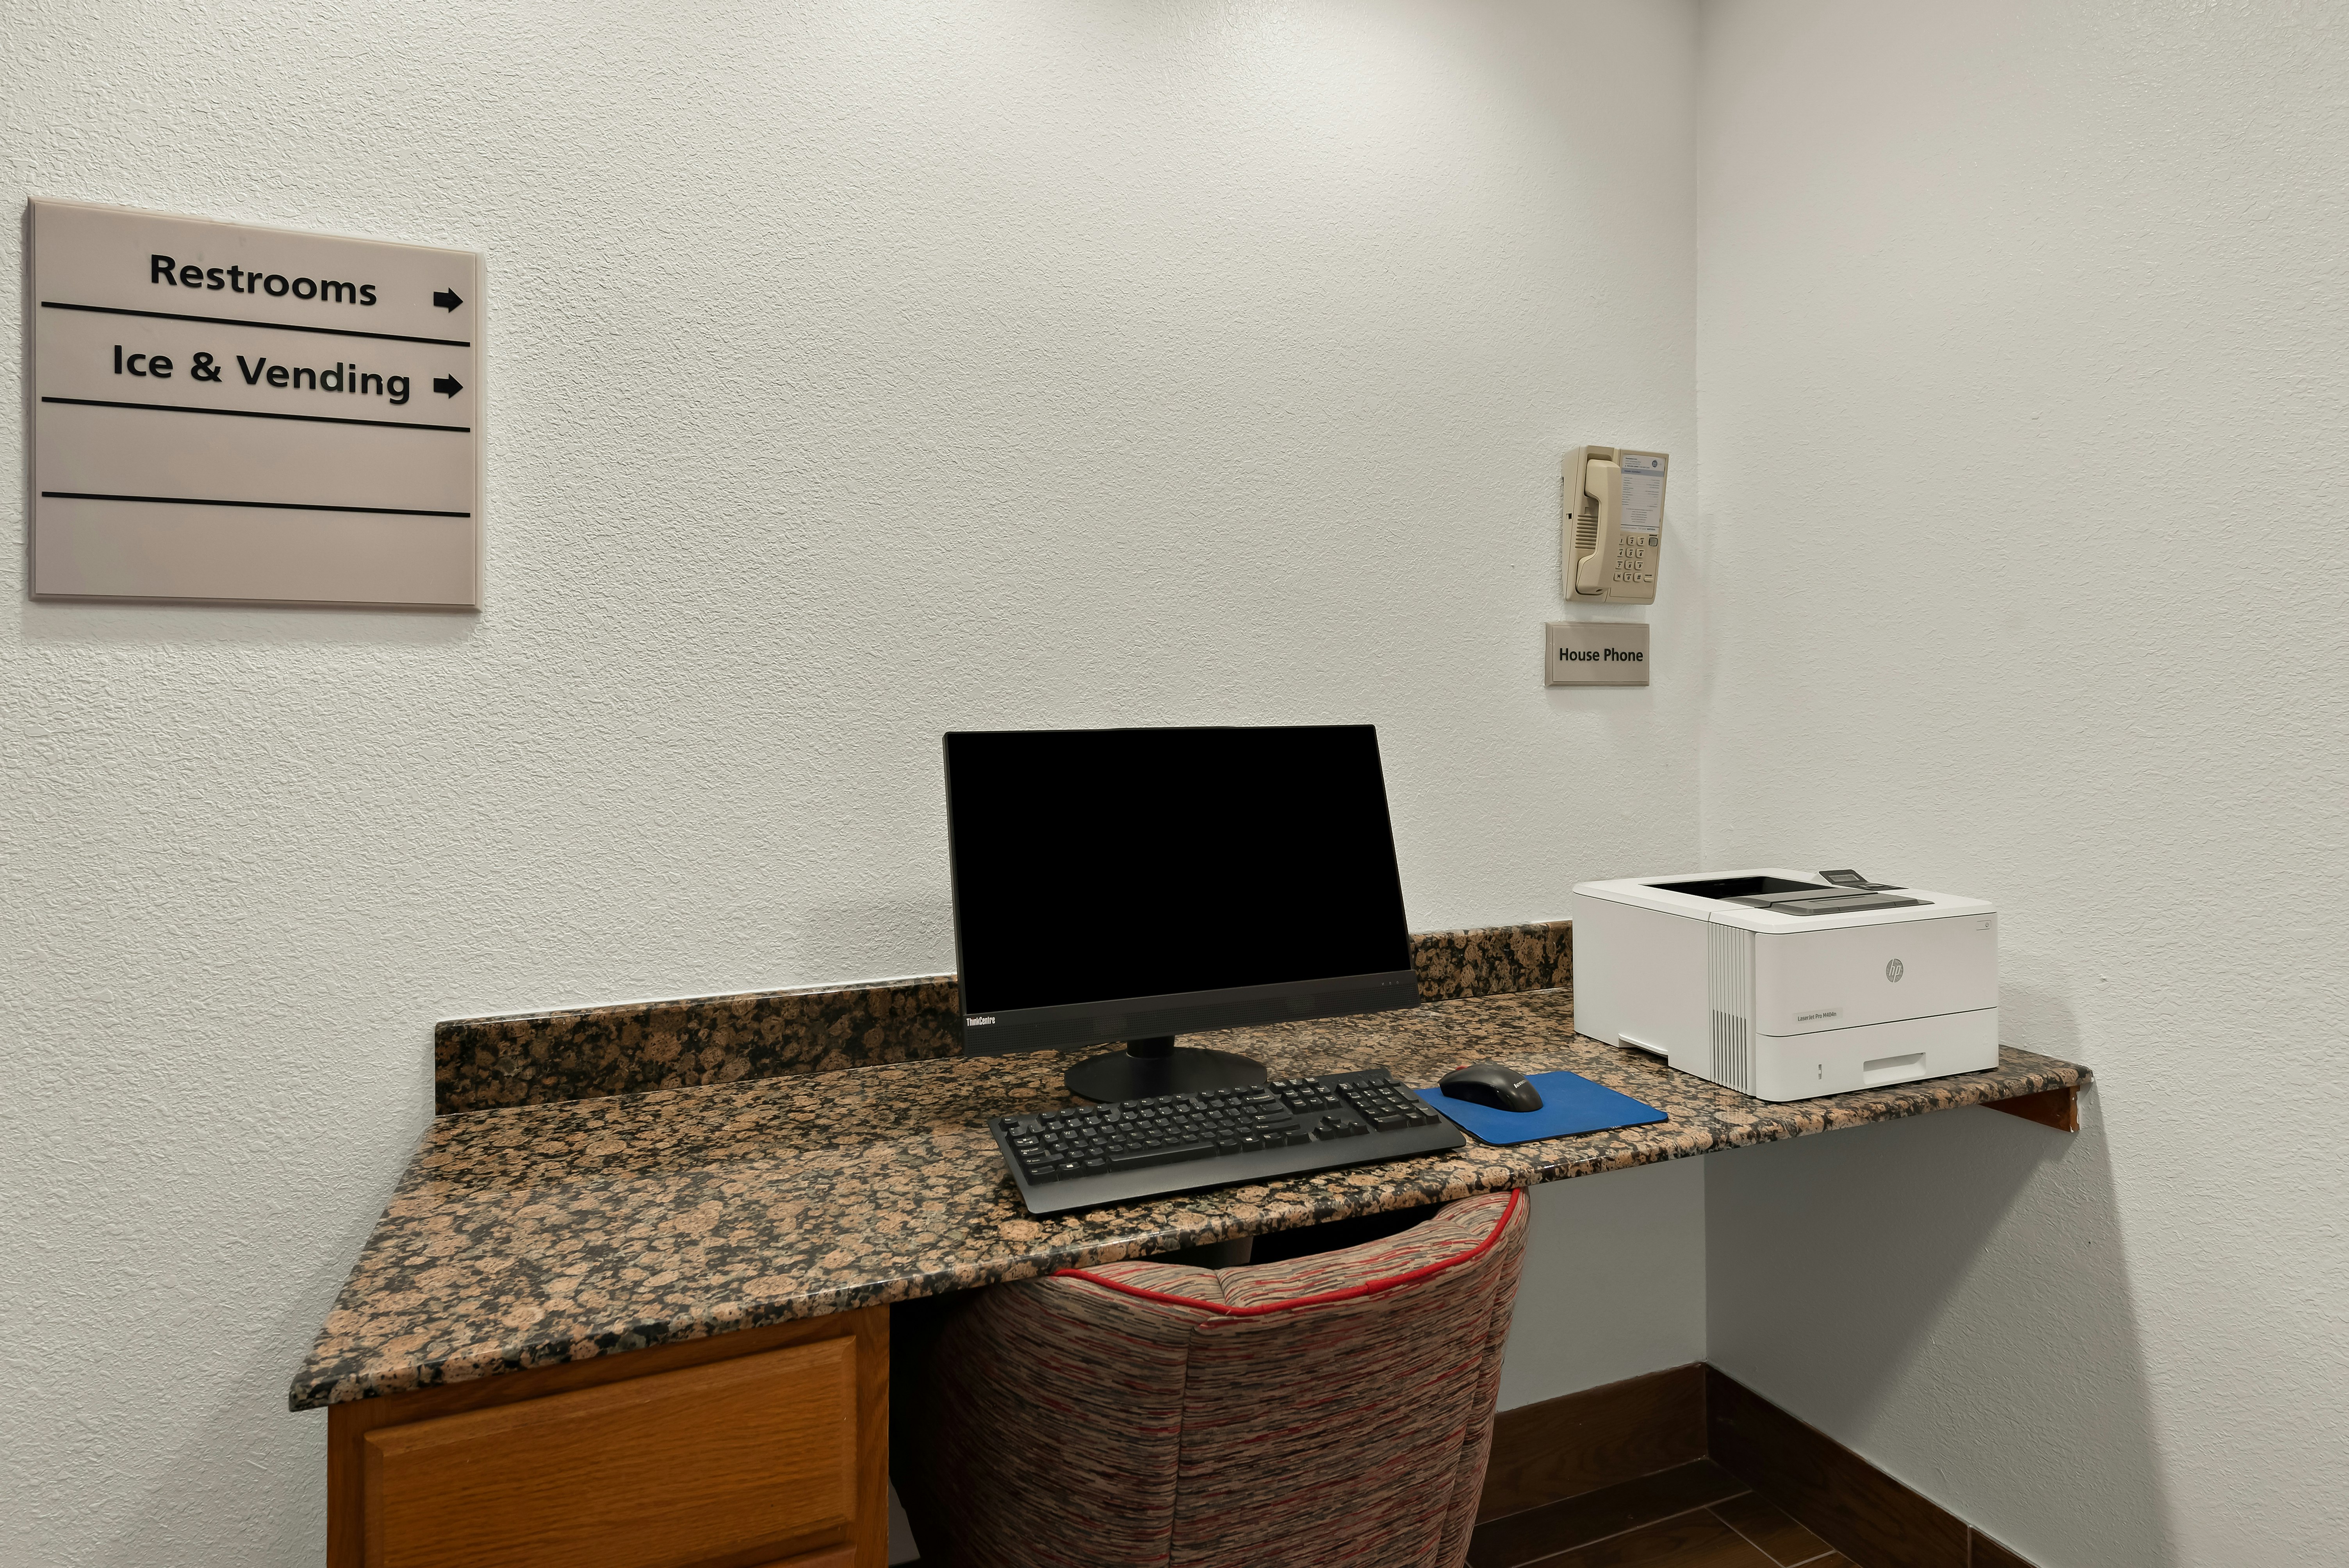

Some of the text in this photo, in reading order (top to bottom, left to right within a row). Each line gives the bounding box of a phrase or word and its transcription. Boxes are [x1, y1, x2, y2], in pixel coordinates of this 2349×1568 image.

[151, 254, 377, 306] Restrooms
[115, 345, 409, 404] Ice & Vending
[1560, 648, 1643, 661] House Phone
[1889, 959, 1901, 982] hp
[966, 1016, 995, 1026] ThinkCentre
